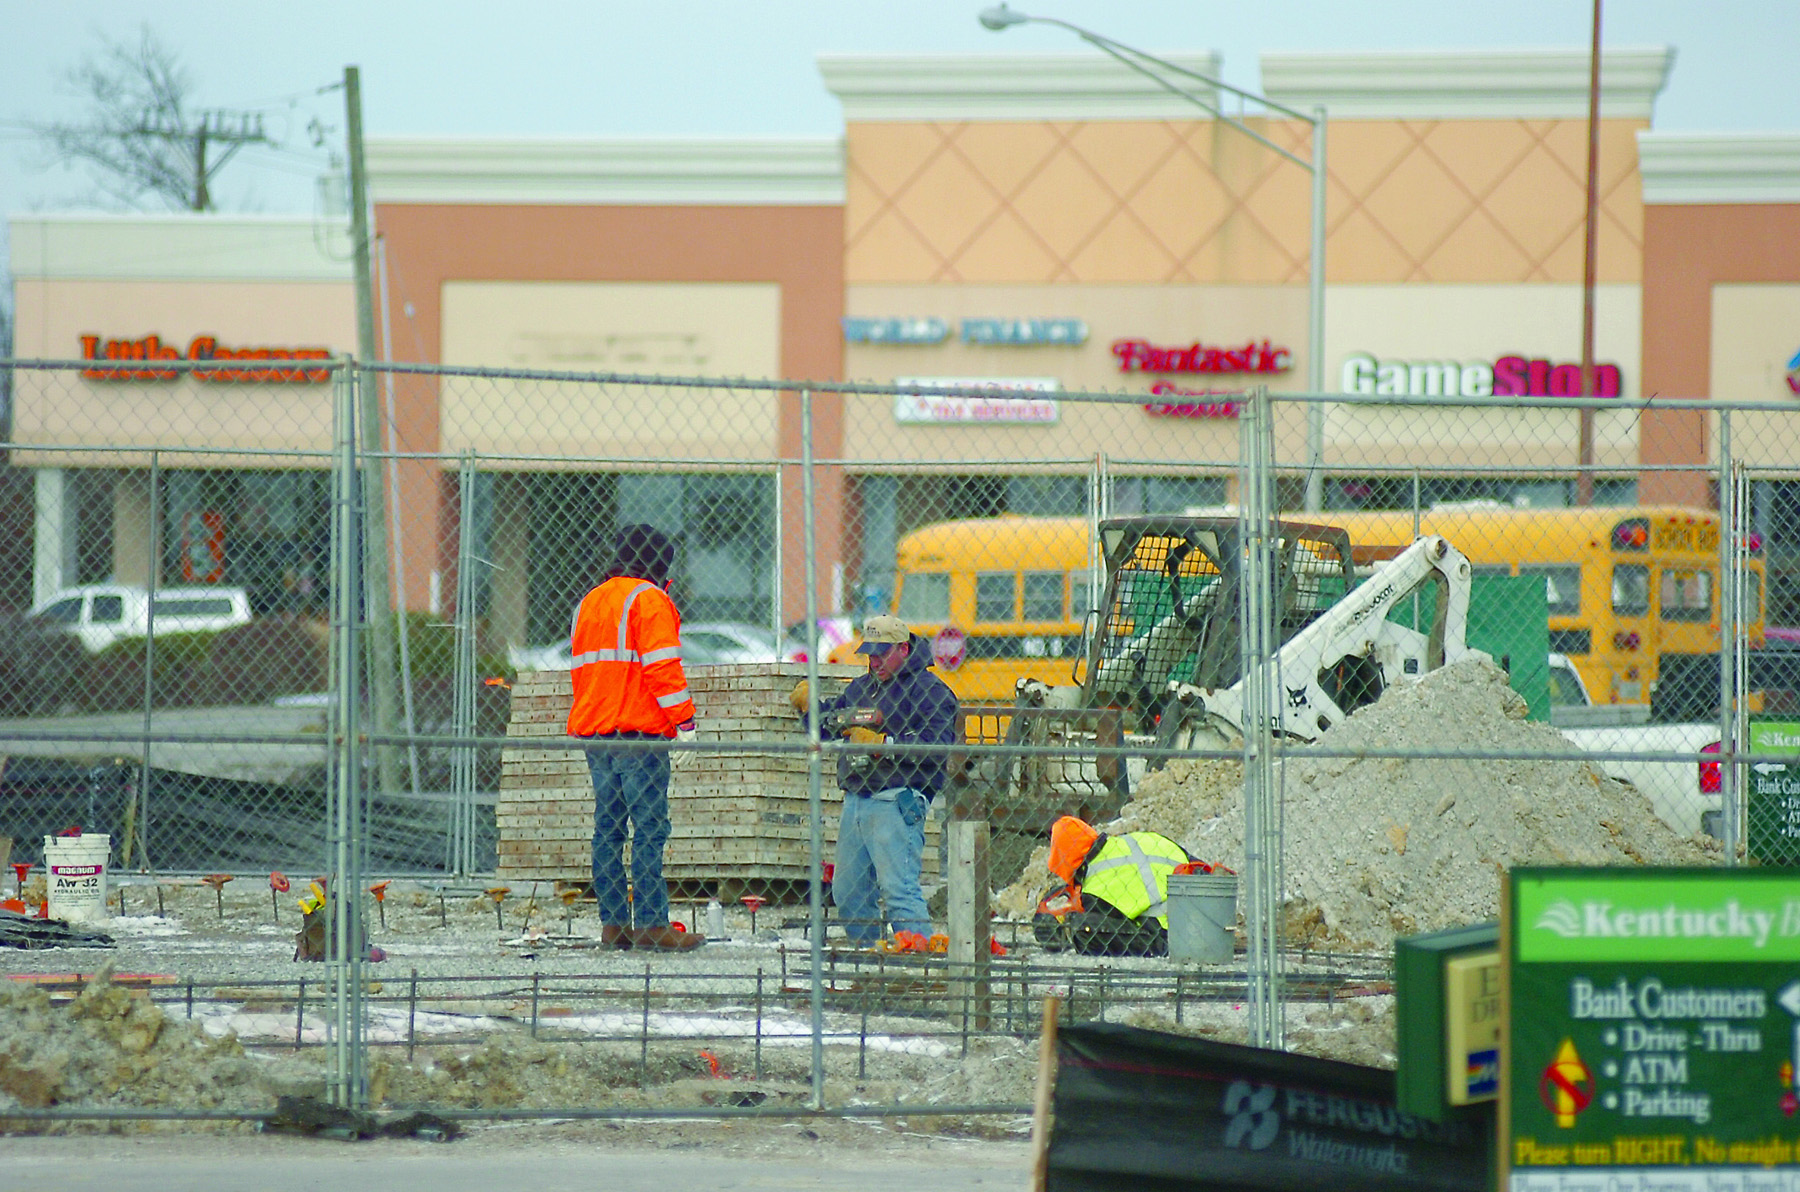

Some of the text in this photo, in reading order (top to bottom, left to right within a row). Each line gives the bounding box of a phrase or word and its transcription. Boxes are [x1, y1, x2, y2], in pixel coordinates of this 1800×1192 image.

[1112, 339, 1292, 373] Fantastic
[1342, 353, 1621, 398] GameStop
[1583, 900, 1774, 948] Kentucky
[1573, 981, 1767, 1019] Bank Customers
[1624, 1024, 1689, 1051] Drive
[1624, 1056, 1689, 1084] ATM
[1624, 1088, 1710, 1124] Parking
[1516, 1138, 1568, 1165] Please
[1573, 1145, 1611, 1165] turn
[1695, 1138, 1726, 1164] No
